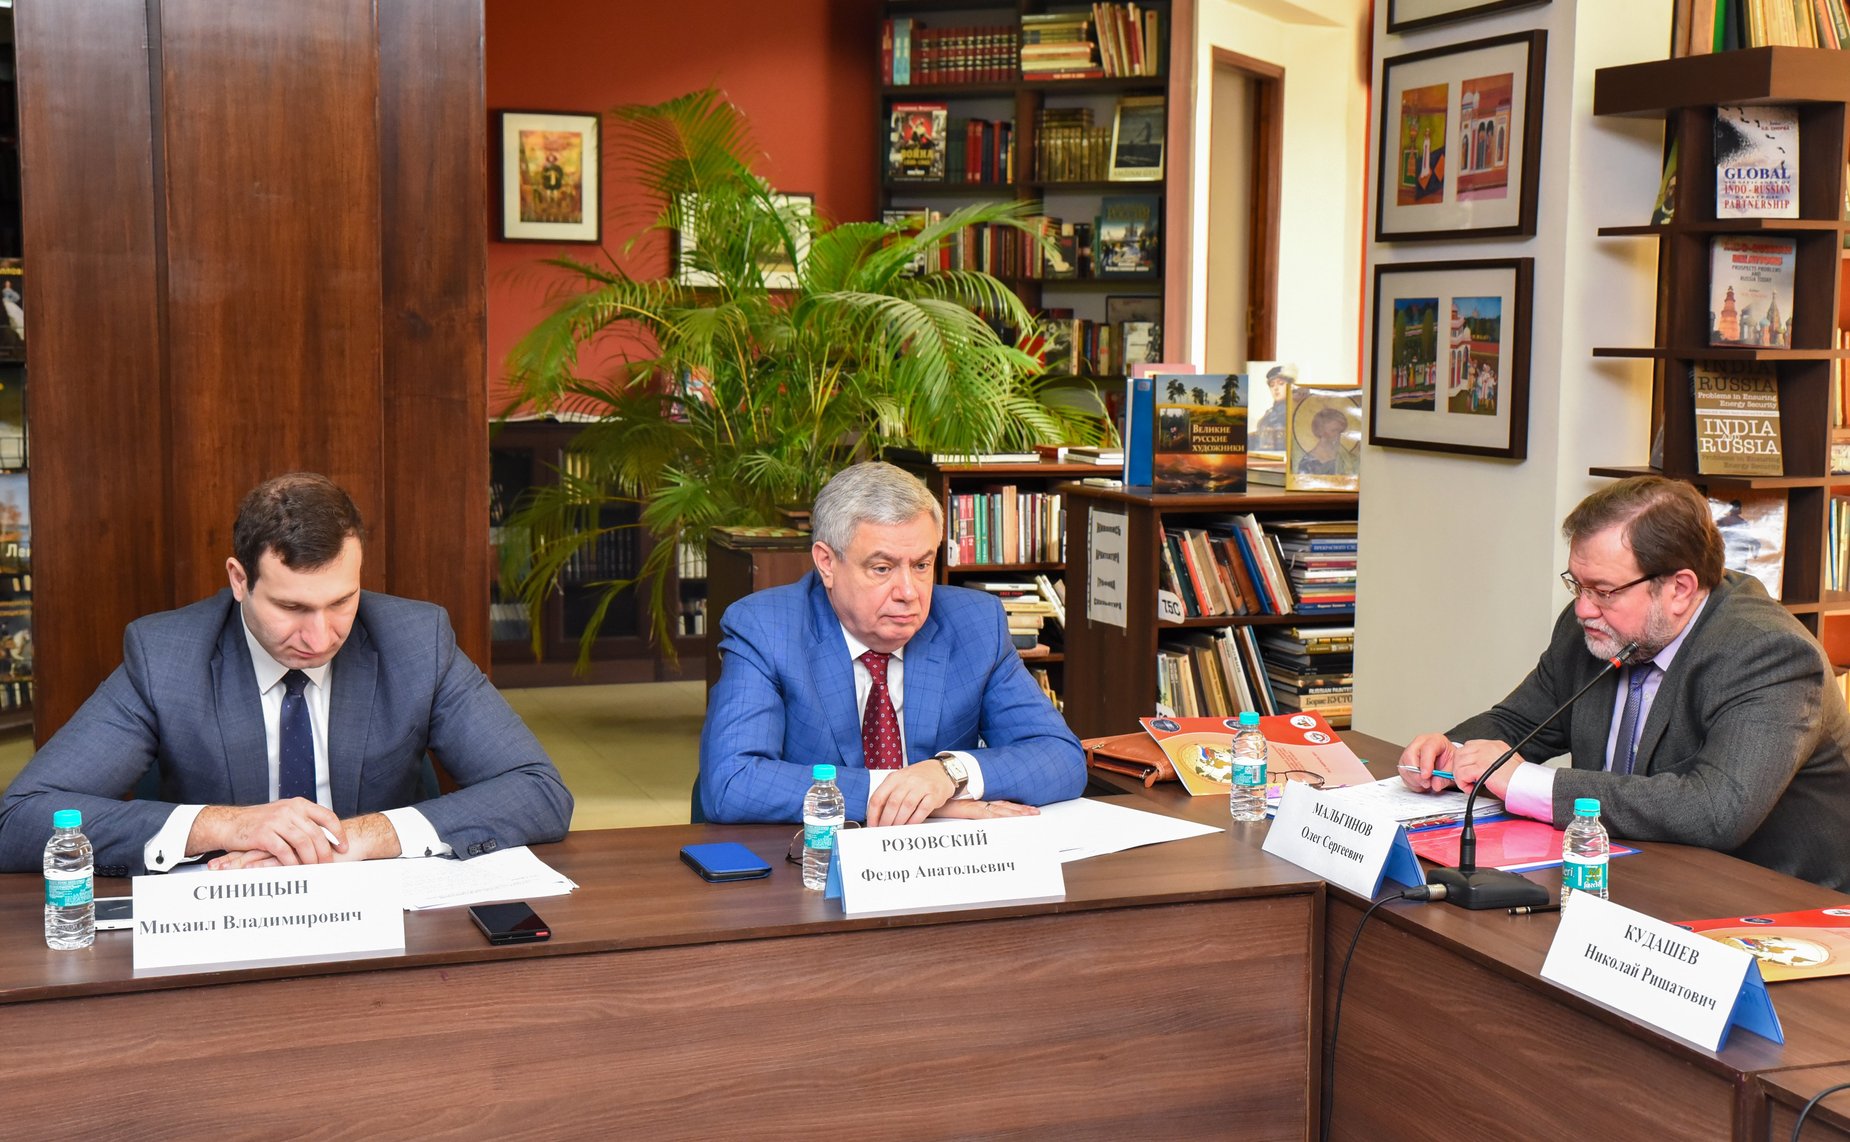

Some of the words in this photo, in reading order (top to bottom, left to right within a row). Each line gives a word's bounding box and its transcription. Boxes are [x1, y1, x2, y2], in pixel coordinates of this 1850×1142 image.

[1724, 167, 1791, 180] GLOBAL
[1724, 184, 1747, 195] INDO
[1753, 184, 1791, 195] RUSSIAN
[1724, 199, 1790, 209] PARTNERSHIP
[1698, 376, 1777, 393] RUSSIA
[1698, 392, 1732, 400] Problems
[1742, 393, 1777, 402] Ensuring
[1720, 400, 1746, 409] Energy
[1747, 401, 1777, 410] Security
[1703, 418, 1777, 437] INDIA
[1699, 437, 1781, 455] RUSSIA
[1312, 801, 1373, 837] МАЛЬГИНОВ
[881, 829, 988, 853] РОЗОВСКИЙ
[1301, 826, 1322, 848] Олег
[1322, 834, 1364, 864] Сергеевич
[861, 867, 910, 883] Федор
[915, 861, 1015, 880] Анатольевич
[193, 879, 309, 901] СИНИЦЫН
[139, 918, 216, 935] Михаил
[223, 910, 363, 931] Владимирович
[1623, 924, 1700, 966] КУДАШЕВ
[1583, 943, 1641, 979] Николай
[1641, 966, 1717, 1012] Ришатович
